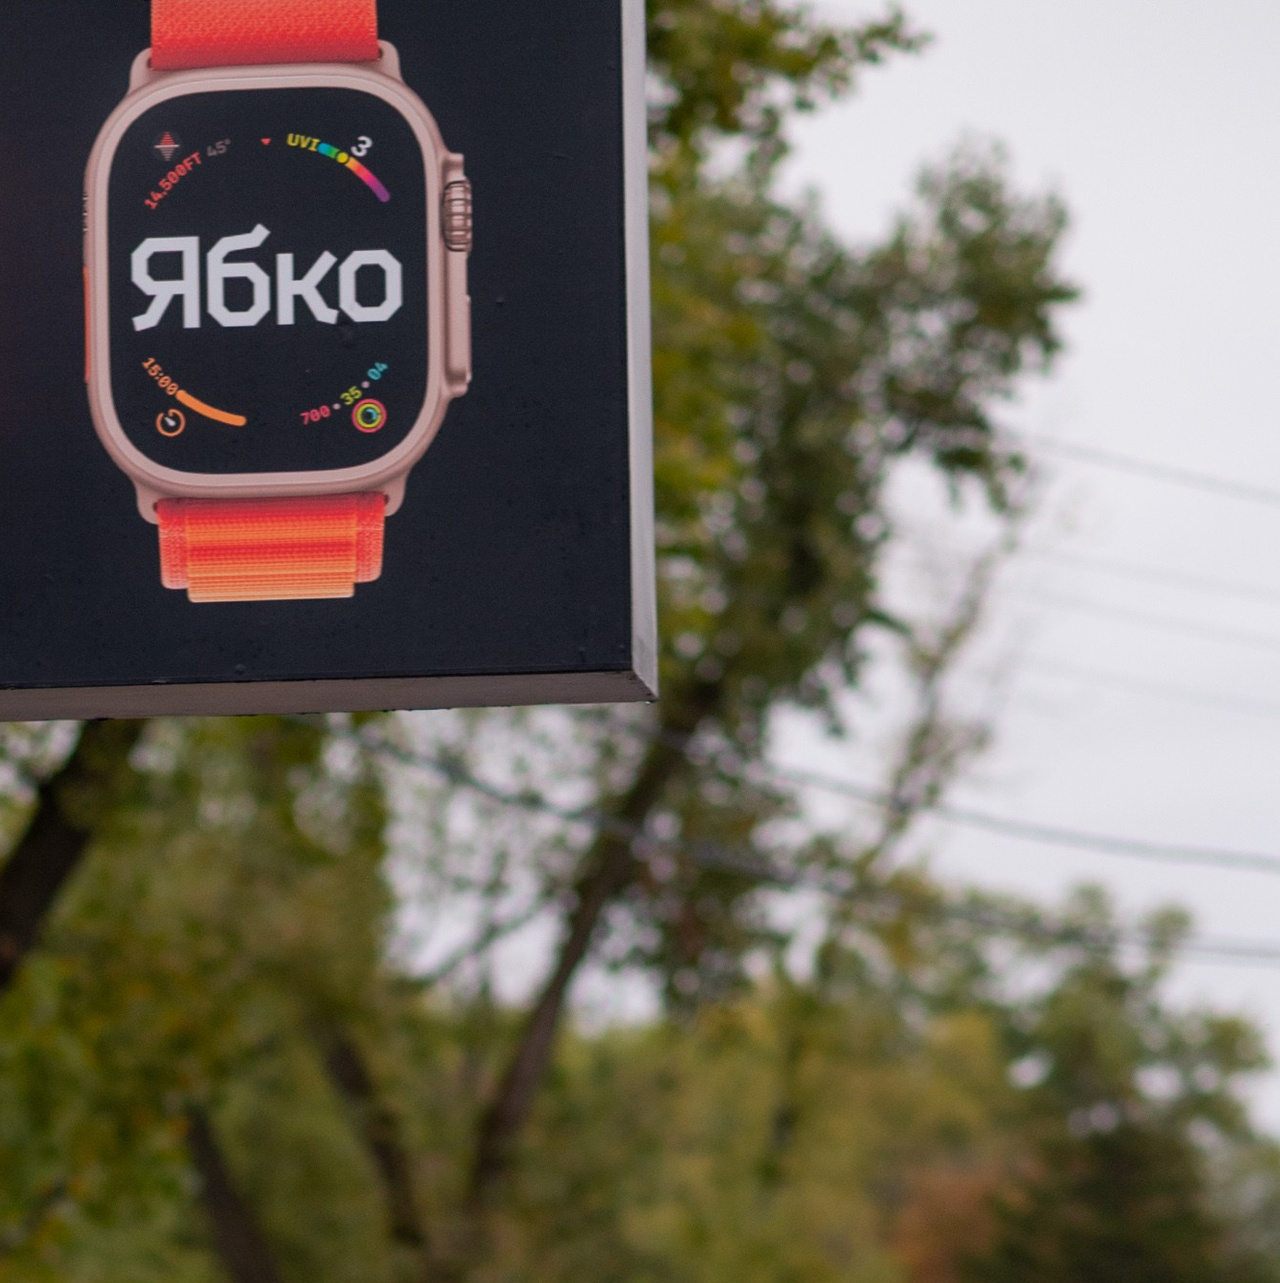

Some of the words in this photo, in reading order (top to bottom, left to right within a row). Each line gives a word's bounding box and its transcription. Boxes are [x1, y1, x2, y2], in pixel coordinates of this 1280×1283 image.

[350, 135, 373, 157] 3
[130, 223, 402, 331] Ябко
[142, 357, 179, 396] 15:00
